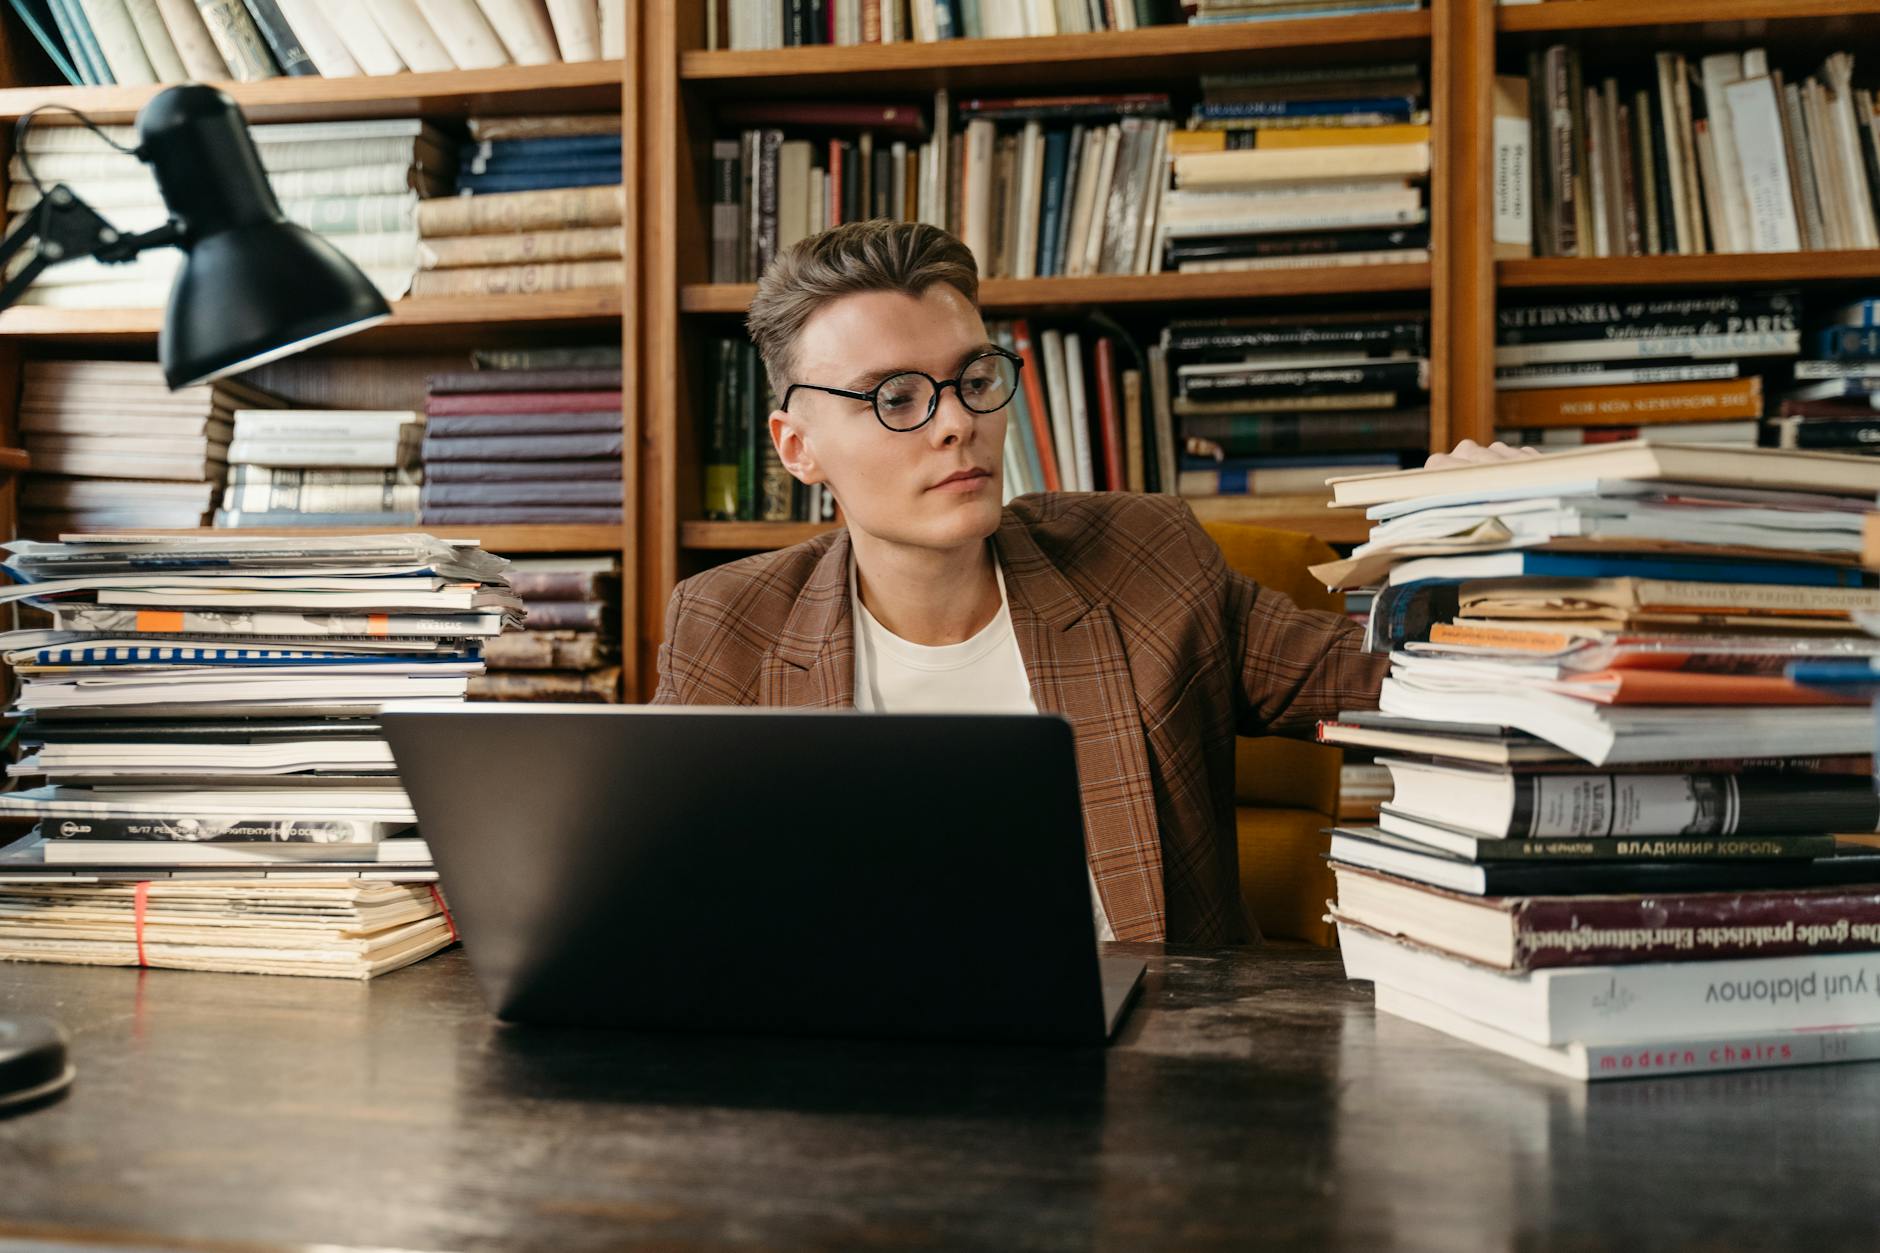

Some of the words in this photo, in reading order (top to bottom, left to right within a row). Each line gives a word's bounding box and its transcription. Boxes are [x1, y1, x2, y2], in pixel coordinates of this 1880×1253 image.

[1726, 314, 1797, 333] PARIS
[1617, 841, 1714, 856] ВЛАДИМИР
[1717, 841, 1781, 856] КОРОЛЬ
[1696, 920, 1794, 949] praktische
[1796, 919, 1849, 946] große
[1705, 971, 1816, 1005] platonov
[1823, 967, 1868, 1001] yuri
[1600, 1048, 1695, 1070] modern
[1709, 1043, 1792, 1064] chairs
